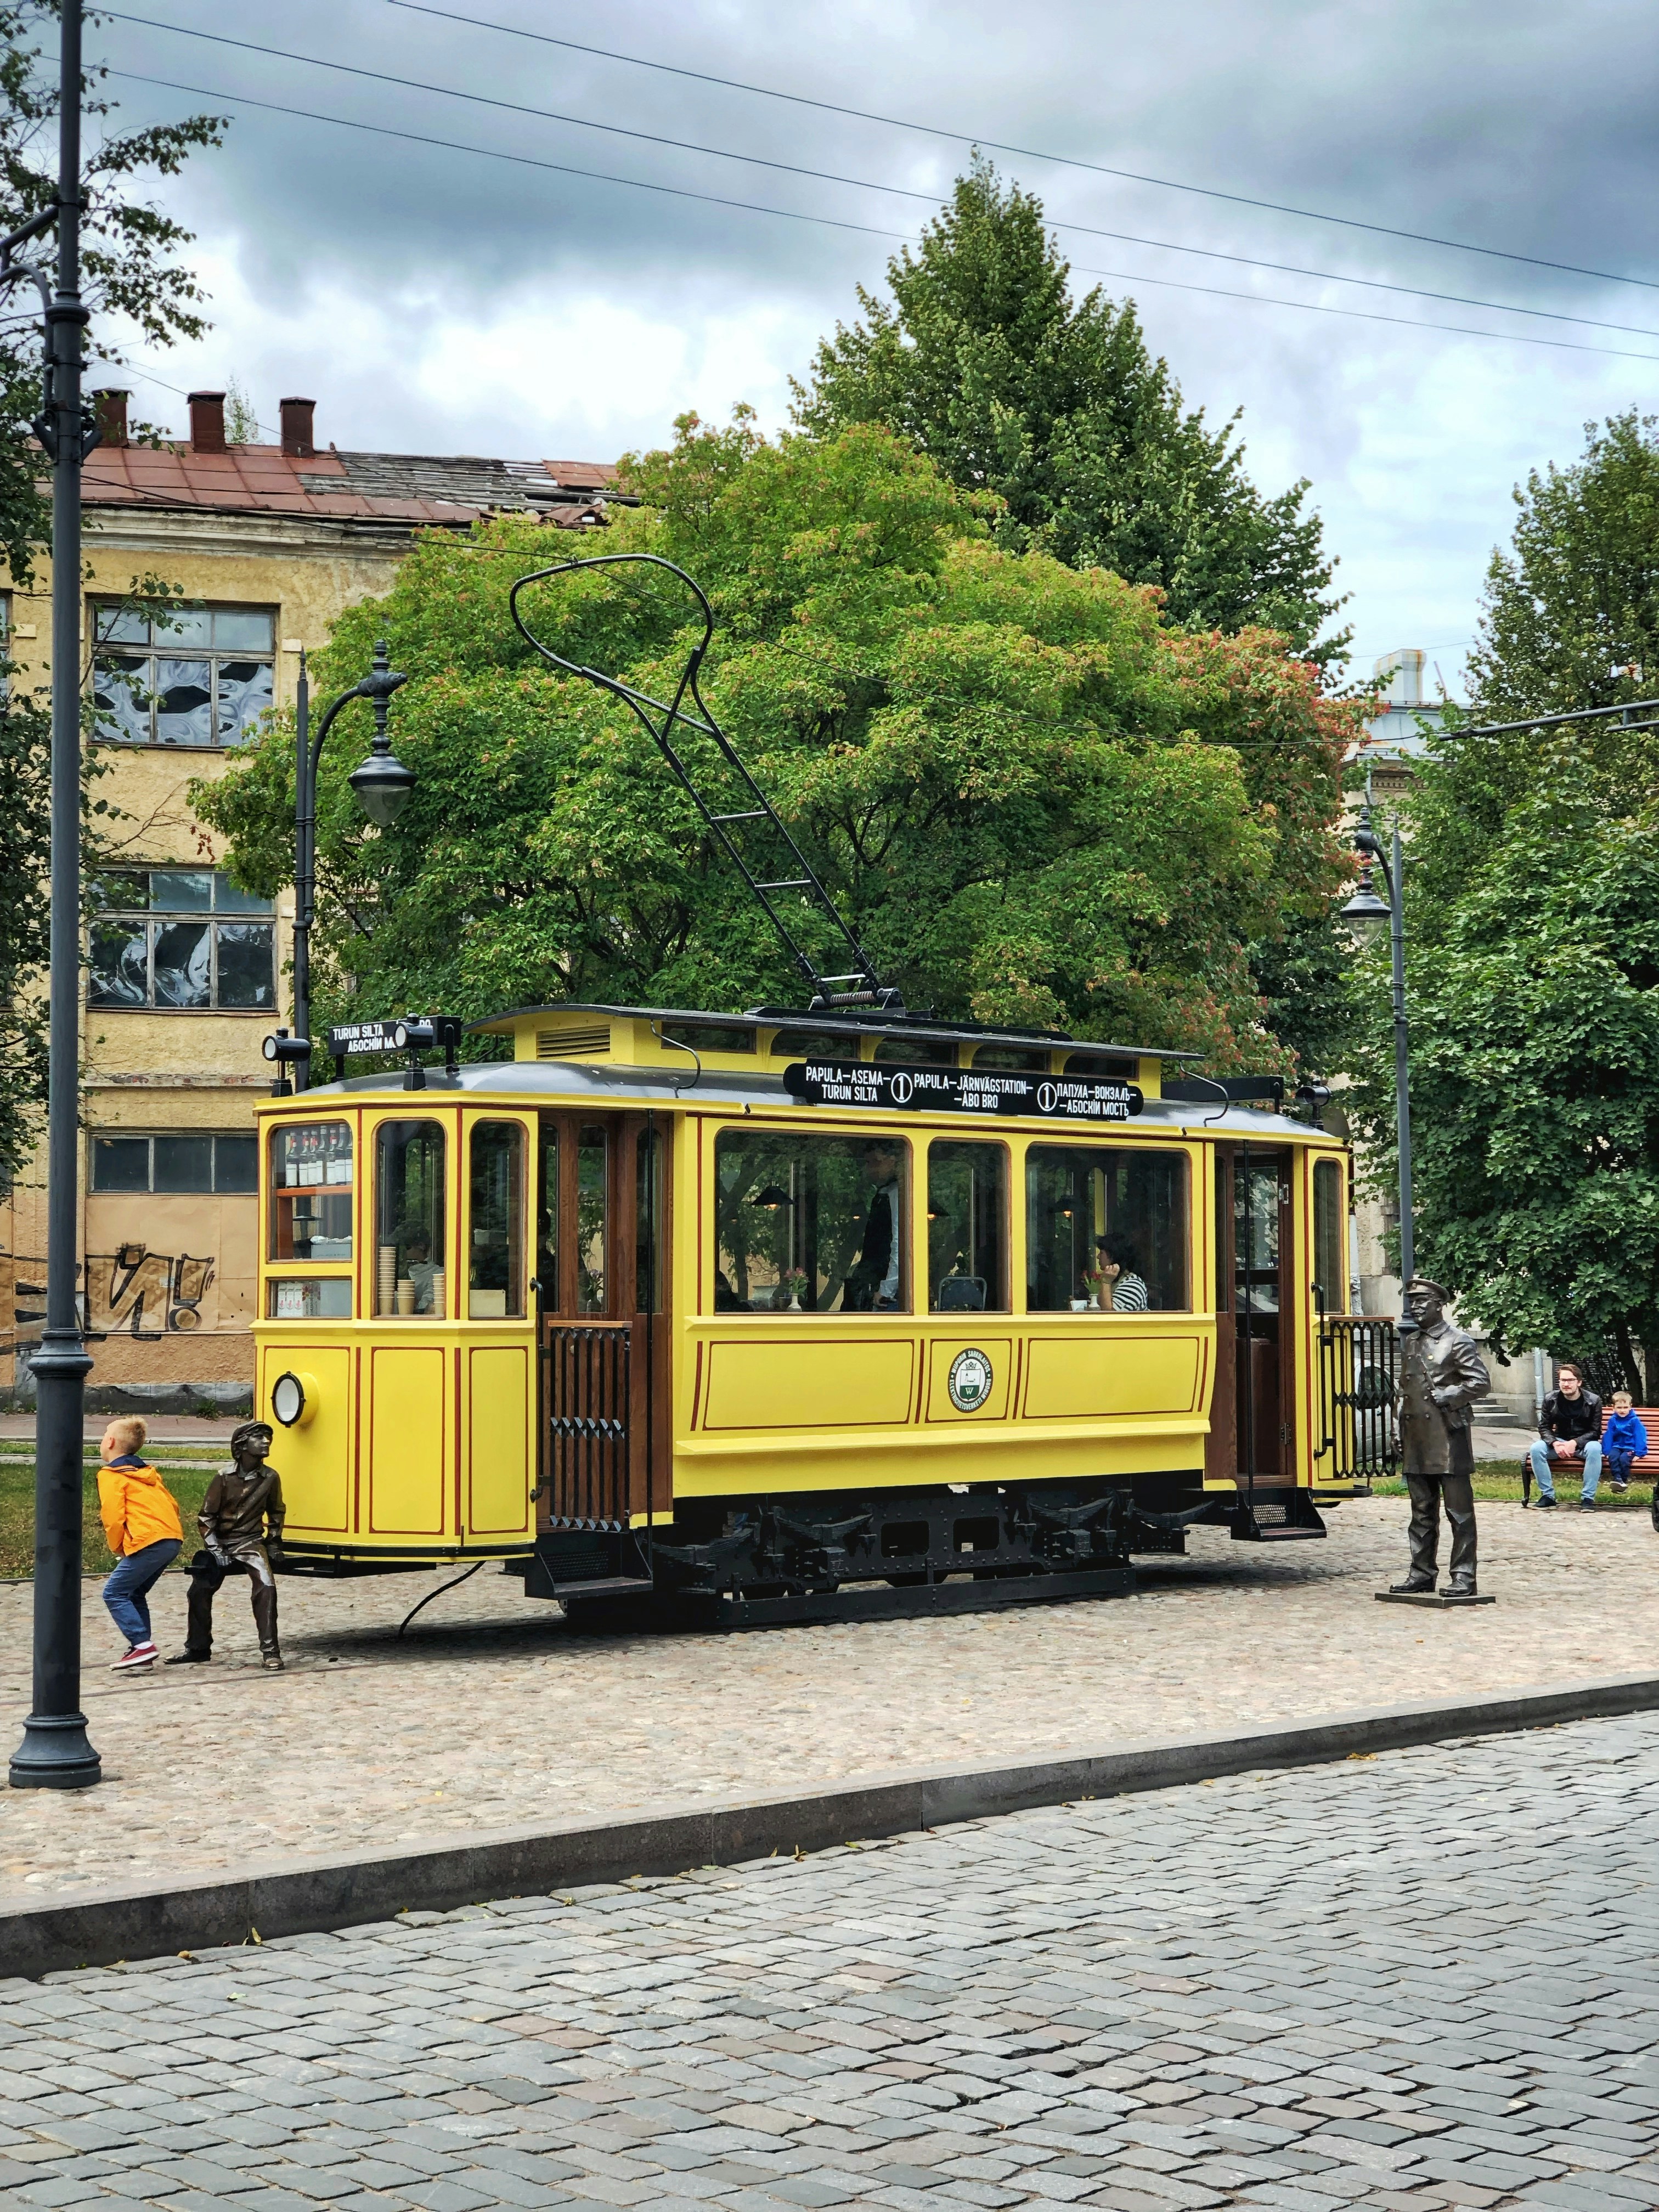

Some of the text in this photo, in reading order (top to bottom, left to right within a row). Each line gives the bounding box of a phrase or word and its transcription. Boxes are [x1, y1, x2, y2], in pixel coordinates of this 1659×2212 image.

[333, 1024, 383, 1041] TURUN SILTA
[822, 1084, 878, 1102] TURUN SILTA
[982, 1093, 998, 1109] BRO
[1103, 1102, 1129, 1116] МОСТЪ
[965, 1387, 974, 1395] W
[981, 1378, 992, 1400] WIBORG
